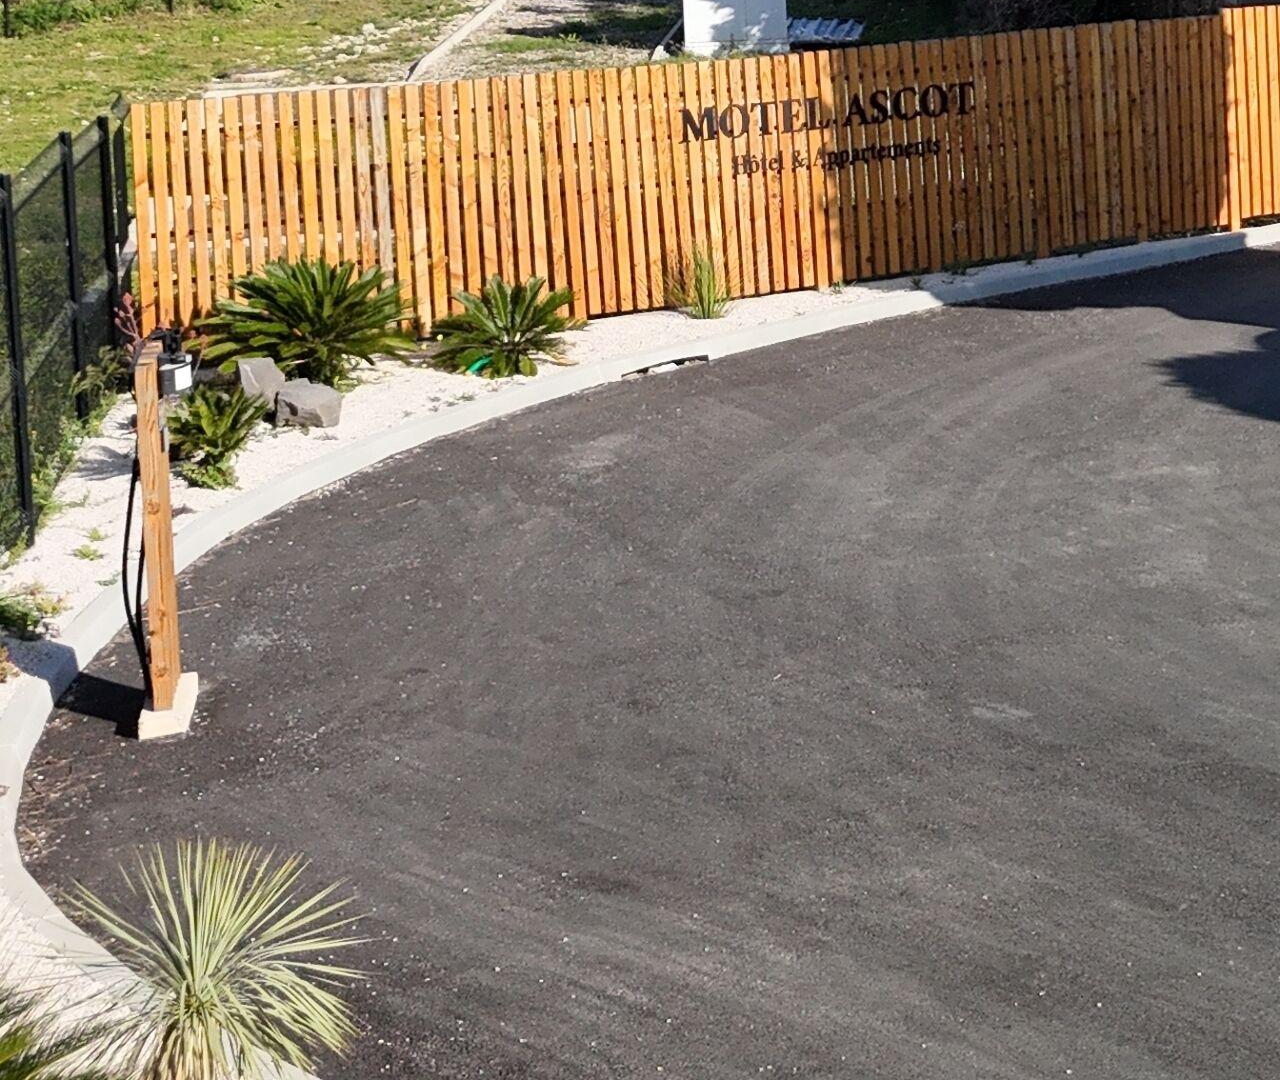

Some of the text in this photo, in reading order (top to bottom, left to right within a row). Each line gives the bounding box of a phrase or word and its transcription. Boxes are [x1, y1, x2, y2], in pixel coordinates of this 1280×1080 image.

[678, 81, 975, 145] MOTEL ASCOT
[731, 136, 941, 175] Hôtel & Appartements
